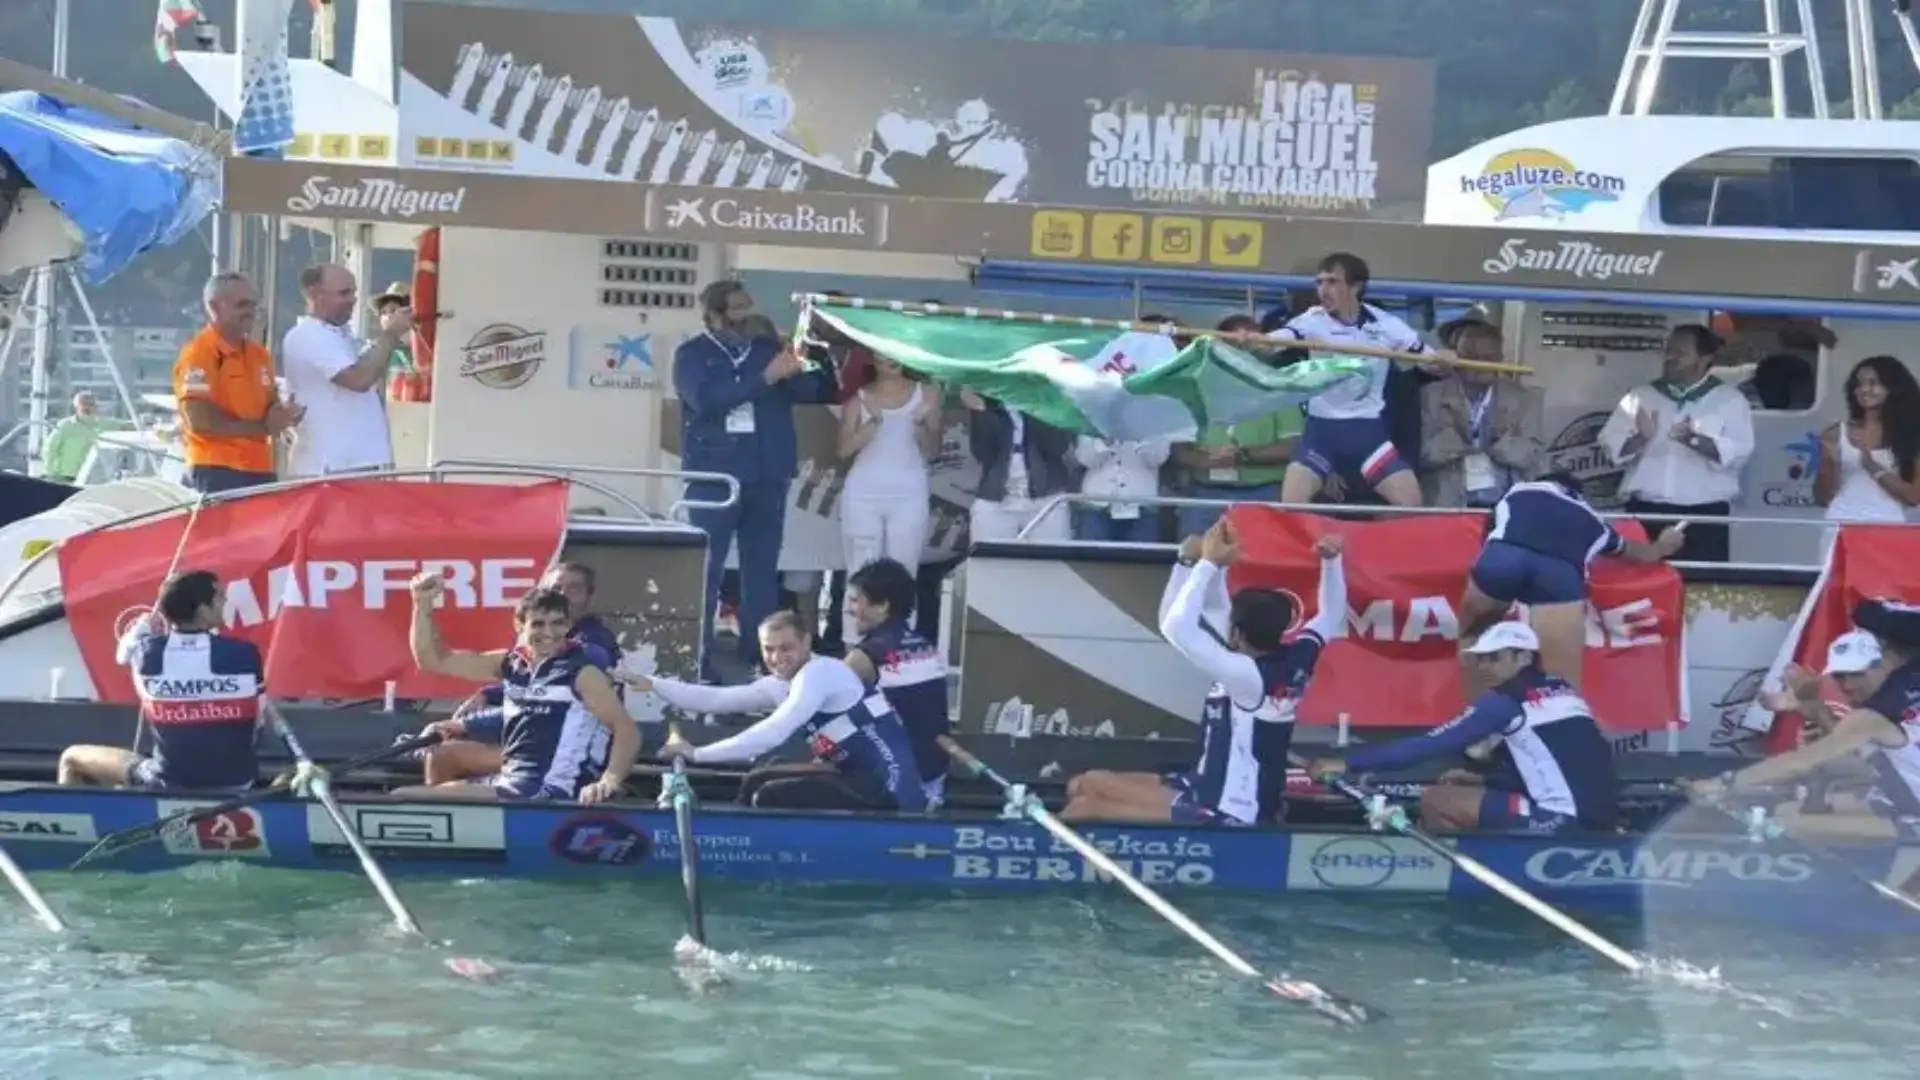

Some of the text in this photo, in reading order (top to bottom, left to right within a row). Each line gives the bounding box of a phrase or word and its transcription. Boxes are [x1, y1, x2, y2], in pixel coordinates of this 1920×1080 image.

[1263, 79, 1355, 123] LIGA
[1089, 111, 1378, 171] SAN MIGUEL
[1087, 158, 1376, 198] CORONA CAIXABANK
[1461, 163, 1626, 194] hegaluze.com
[710, 198, 866, 236] CaixaBank
[144, 677, 241, 697] CAMPOS
[151, 702, 241, 722] Urdaibai
[653, 828, 752, 848] Euopea
[953, 827, 1037, 851] Bou
[952, 854, 1215, 886] BERMEO
[1524, 847, 1816, 884] CAMPOS
